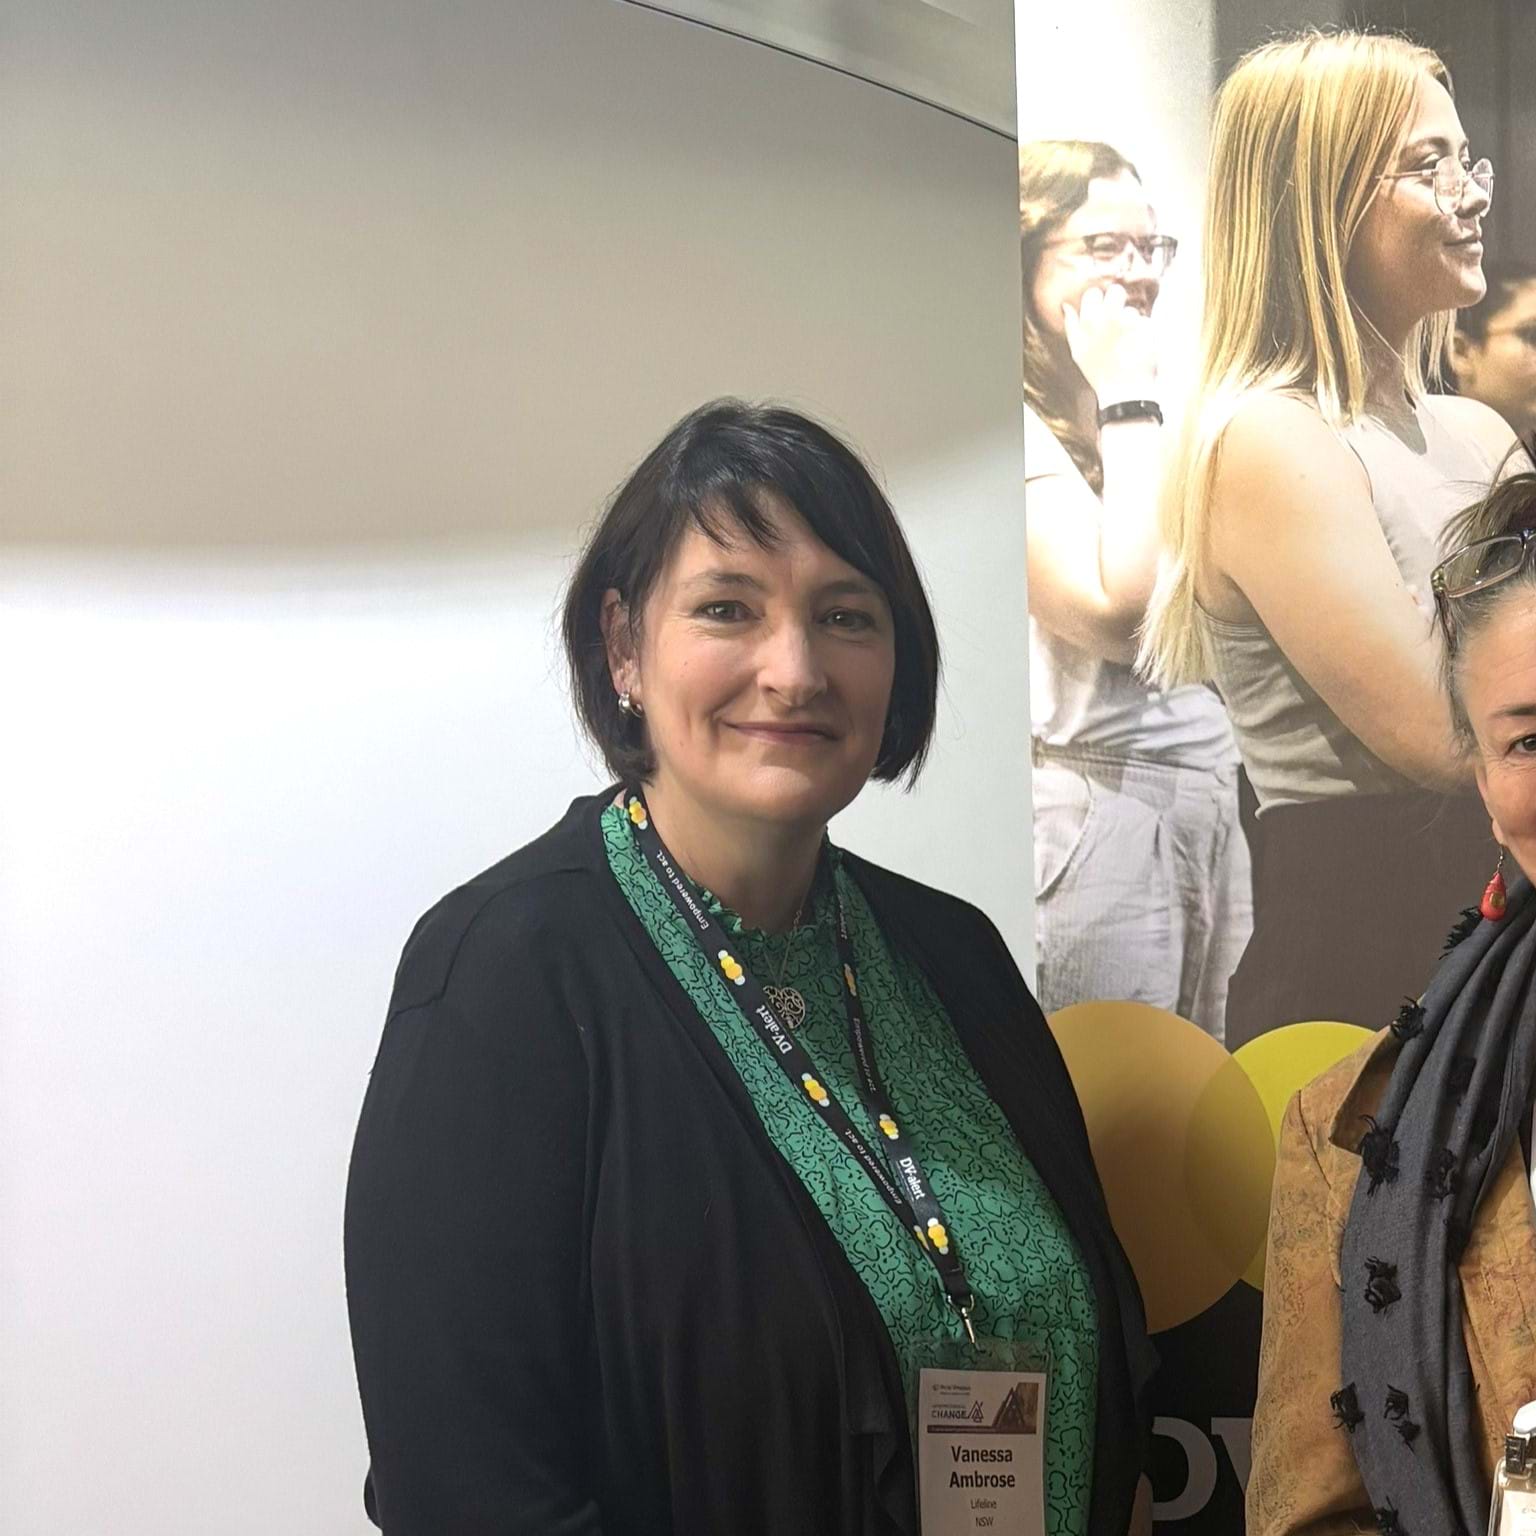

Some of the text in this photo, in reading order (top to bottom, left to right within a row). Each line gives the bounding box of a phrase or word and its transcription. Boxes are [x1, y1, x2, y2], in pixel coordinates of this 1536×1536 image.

[756, 1004, 793, 1054] DV-alert
[950, 1444, 1013, 1463] Vanessa
[949, 1470, 1016, 1489] Ambrose
[975, 1516, 994, 1528] NSW
